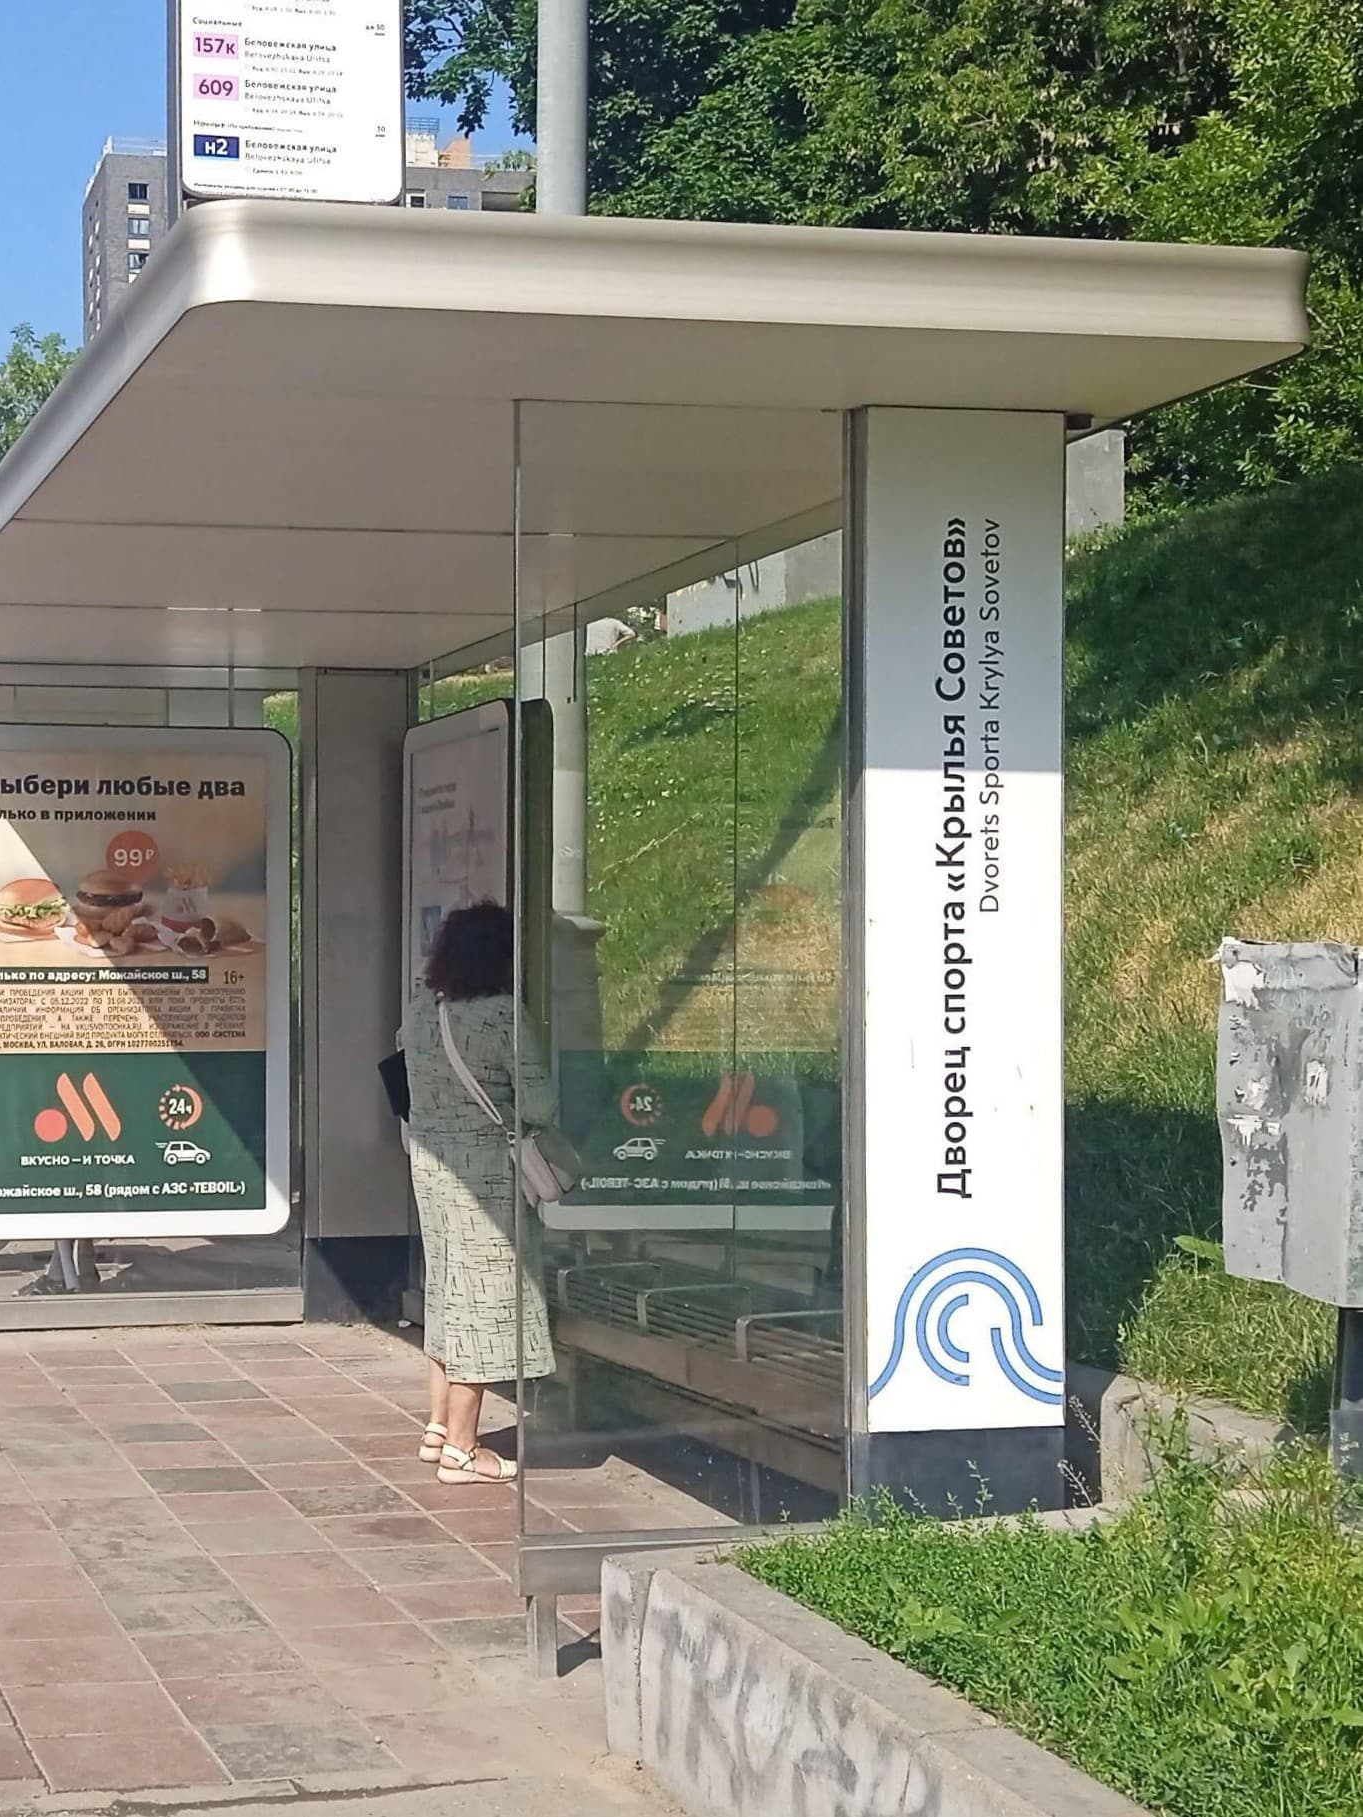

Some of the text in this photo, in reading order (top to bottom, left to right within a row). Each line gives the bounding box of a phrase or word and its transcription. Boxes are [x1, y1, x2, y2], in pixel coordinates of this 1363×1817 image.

[195, 37, 235, 54] 157к
[199, 78, 233, 96] 609
[978, 518, 1005, 912] Dvorets Sporta Krylya Sovetov
[97, 775, 192, 796] любые
[198, 780, 245, 800] два
[41, 810, 50, 820] в
[54, 809, 156, 823] приложении
[935, 517, 974, 1199] Дворец спорта «Крылья Советов»
[29, 971, 45, 980] по
[47, 971, 96, 982] адресу:
[98, 969, 169, 981] Можайское
[171, 970, 189, 981] ш.,
[191, 969, 206, 979] 58
[224, 970, 245, 984] 16+
[20, 1155, 70, 1166] ВКУСНО
[82, 1155, 92, 1165] И
[94, 1154, 135, 1165] ТОЧКА
[63, 1186, 82, 1199] ш.,
[85, 1183, 102, 1196] 58
[104, 1183, 150, 1198] (рядом
[152, 1185, 160, 1195] с
[161, 1182, 188, 1194] АЗС
